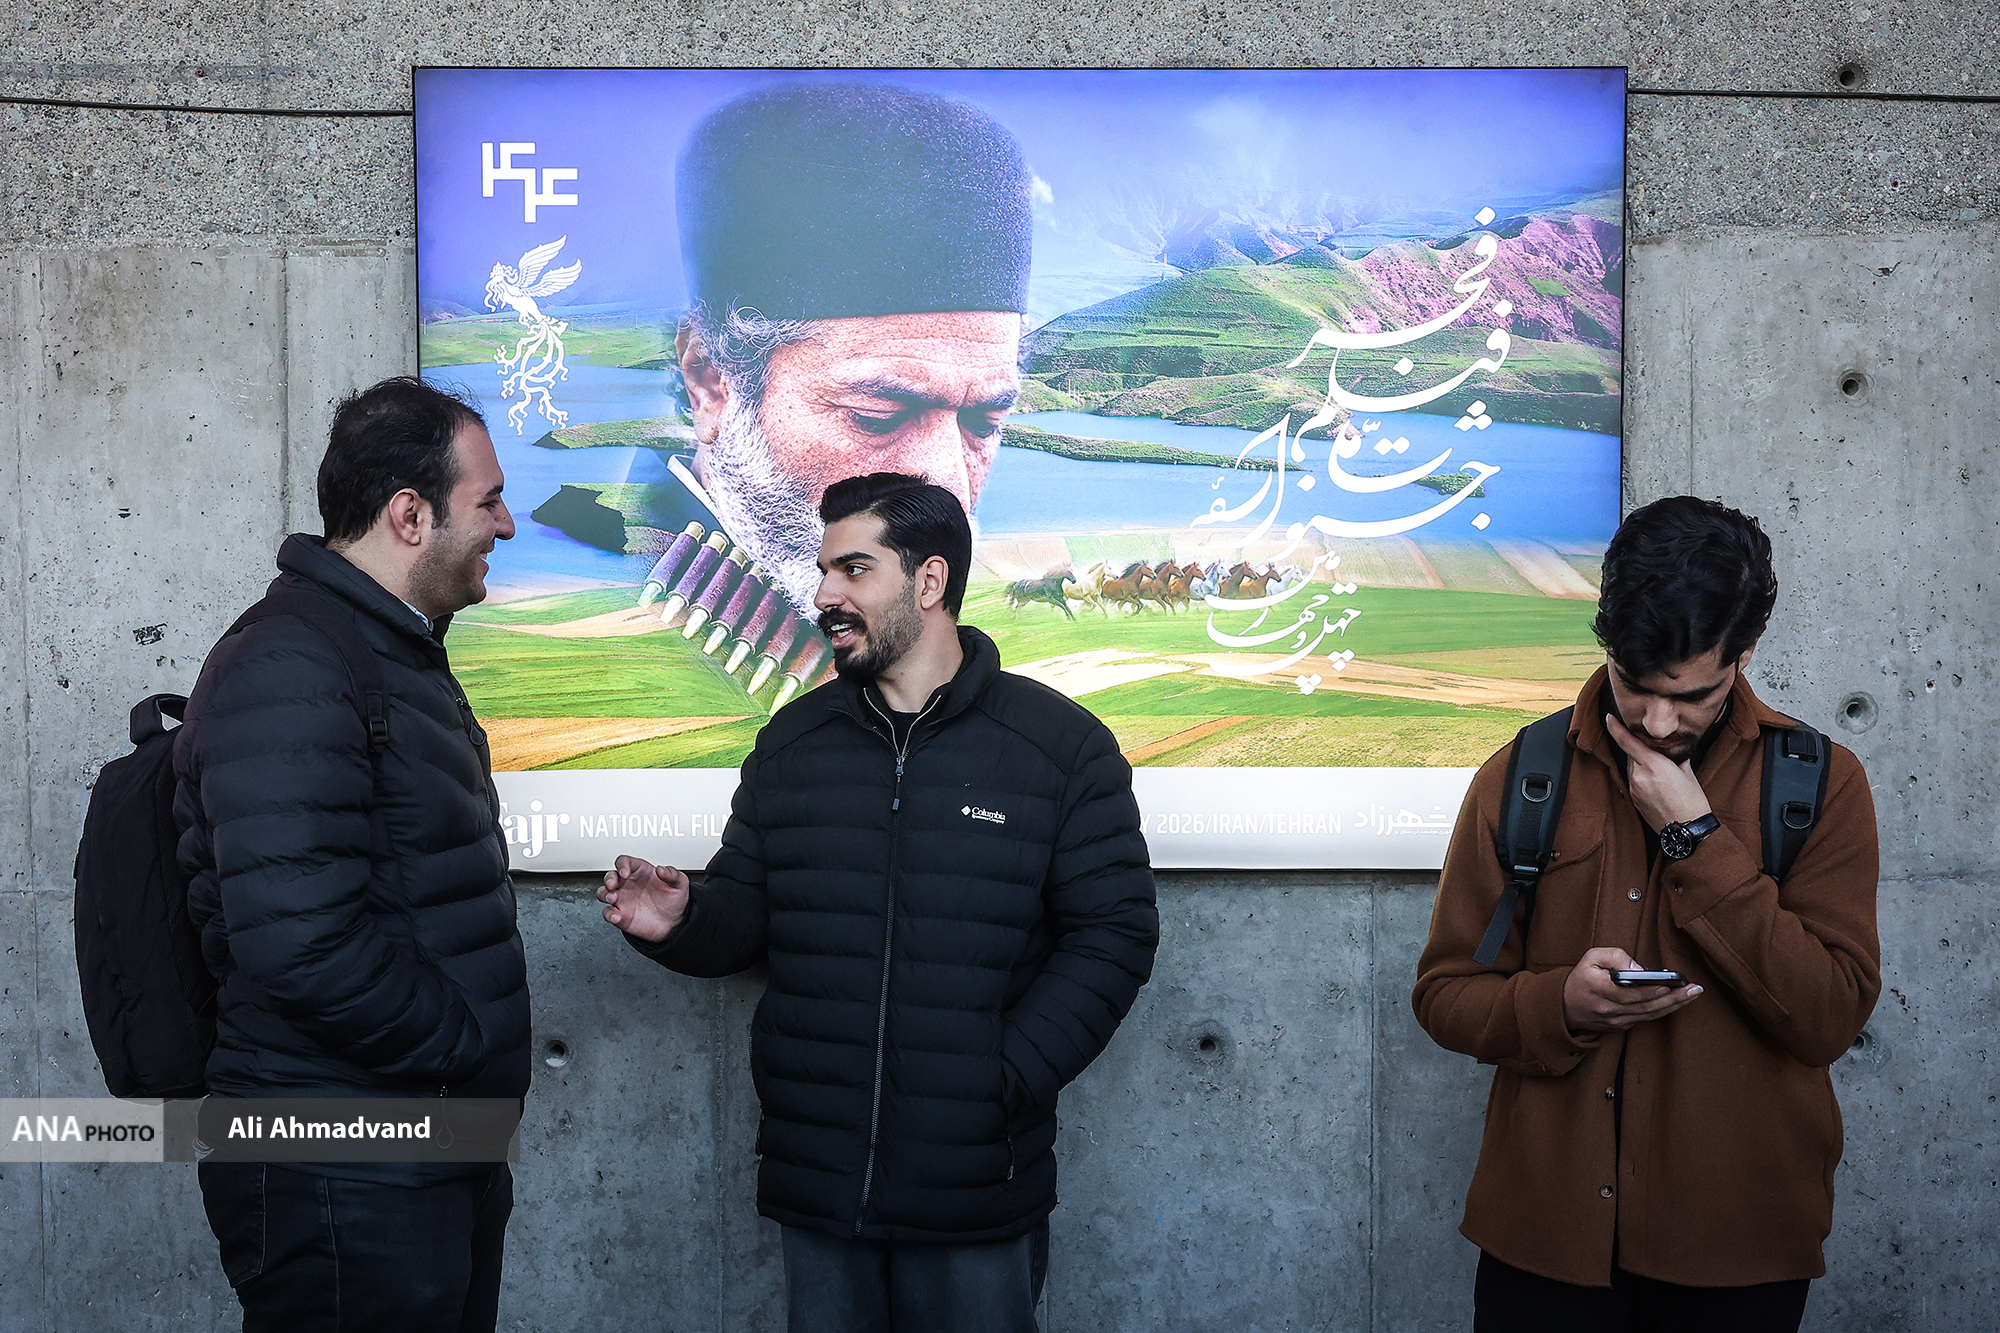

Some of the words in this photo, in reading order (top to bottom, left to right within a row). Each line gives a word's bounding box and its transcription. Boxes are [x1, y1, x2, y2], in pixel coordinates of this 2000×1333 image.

[1286, 206, 1499, 376] فجر
[579, 813, 685, 838] NATIONAL
[972, 806, 1006, 821] Columbia
[1353, 802, 1453, 836] شهرزاد
